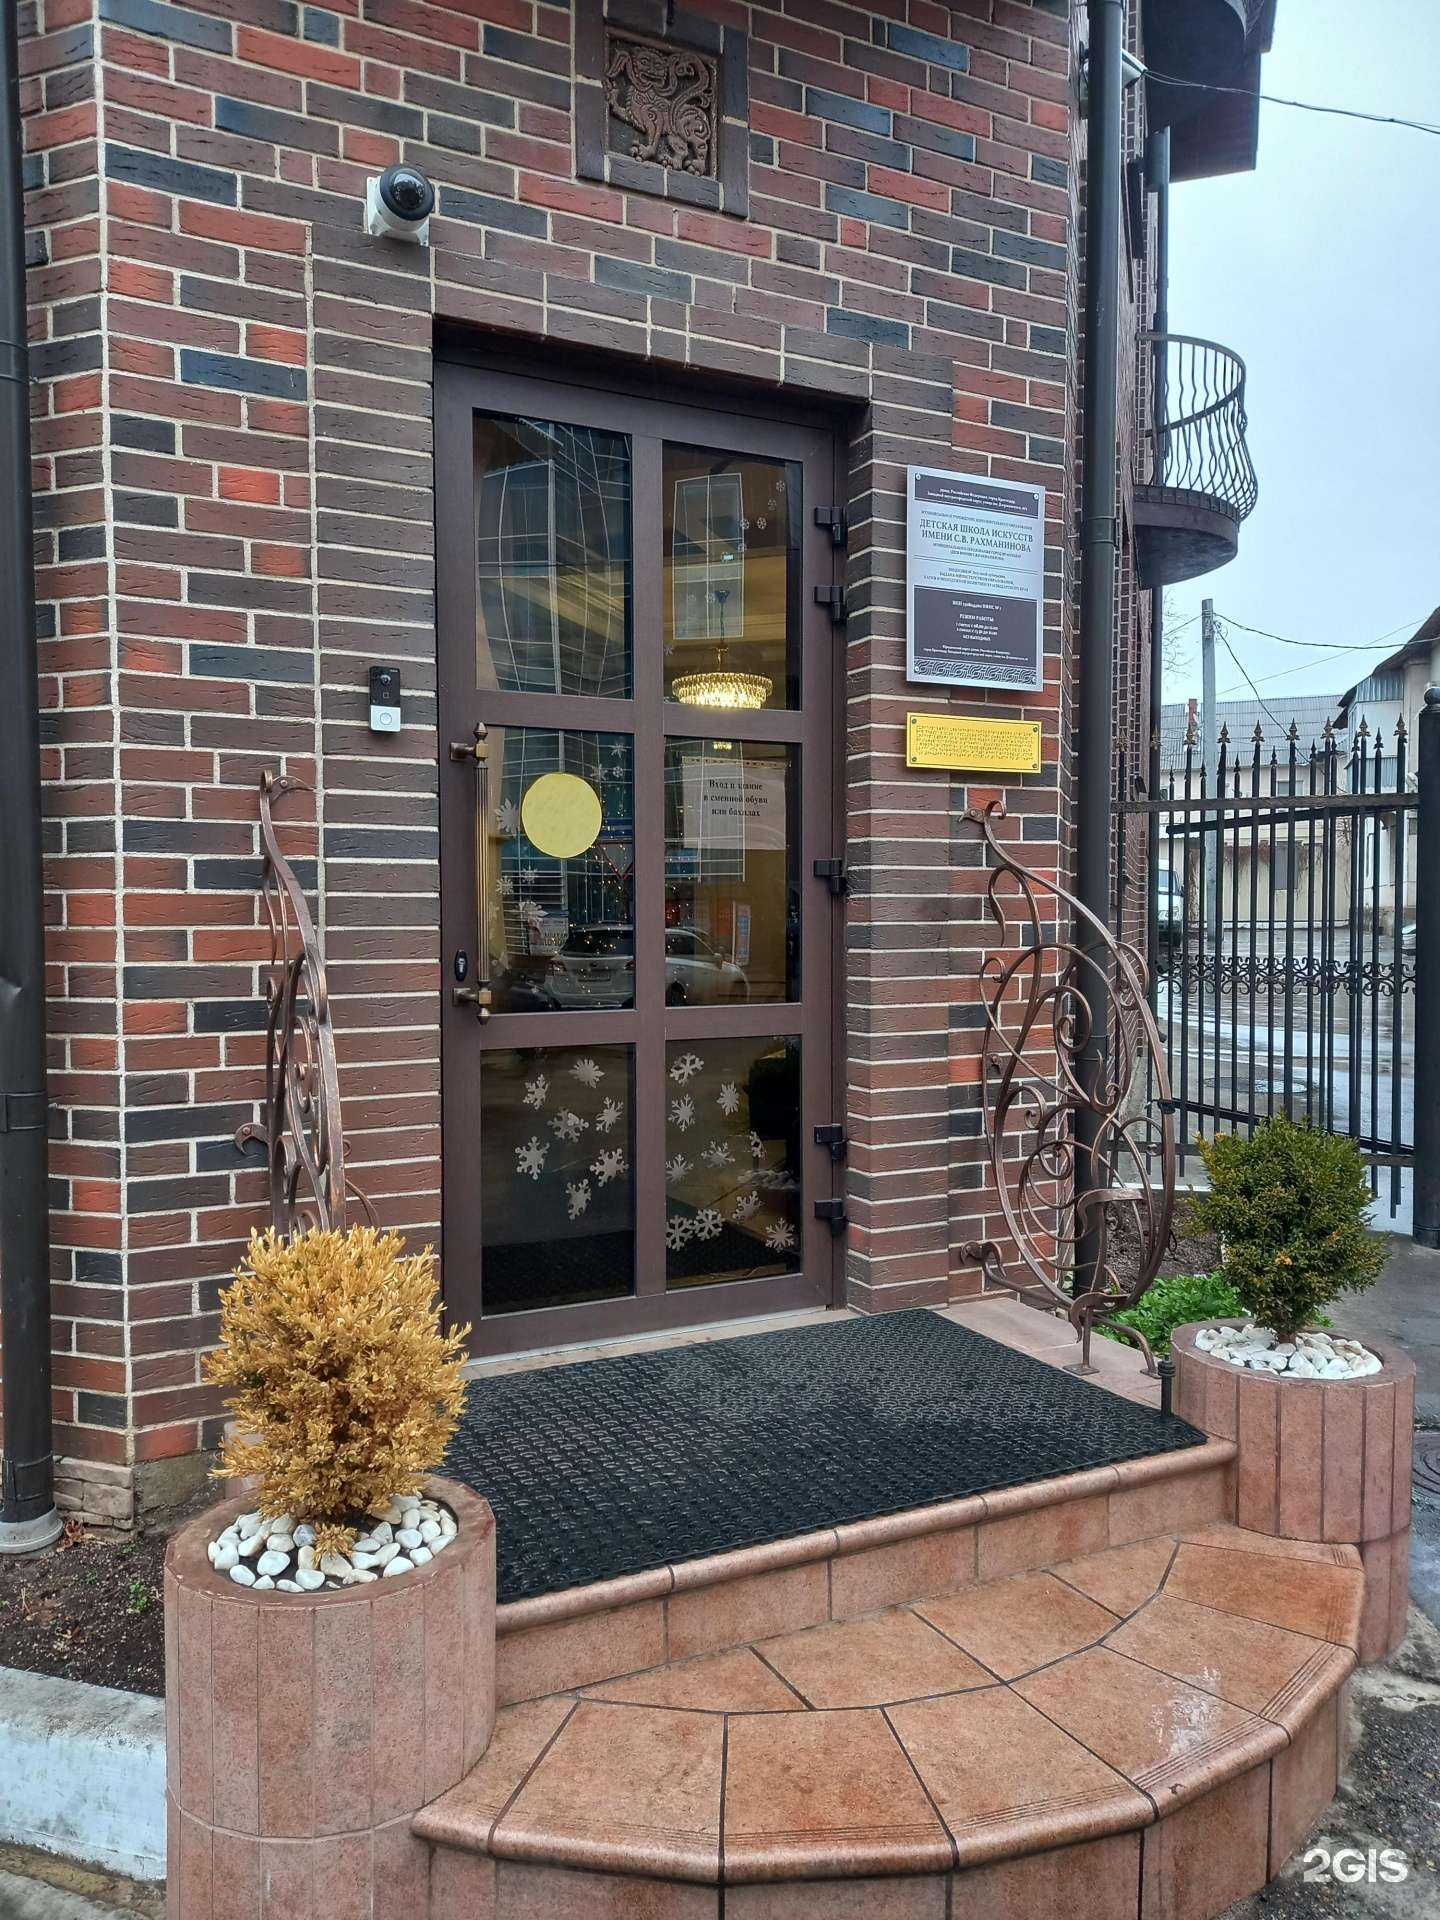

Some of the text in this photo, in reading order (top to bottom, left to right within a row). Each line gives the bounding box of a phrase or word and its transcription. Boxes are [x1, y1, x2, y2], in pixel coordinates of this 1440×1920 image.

[919, 518, 958, 532] ДЕТСКАЯ
[960, 524, 991, 537] ШКОЛА
[991, 528, 1034, 543] ИСКУССТВ
[921, 529, 953, 542] ИМЕНИ
[970, 536, 1032, 553] РАХМАНИНОВА
[709, 779, 728, 790] Вход
[710, 793, 743, 803] сменной
[745, 795, 768, 805] обуви
[711, 808, 727, 816] или
